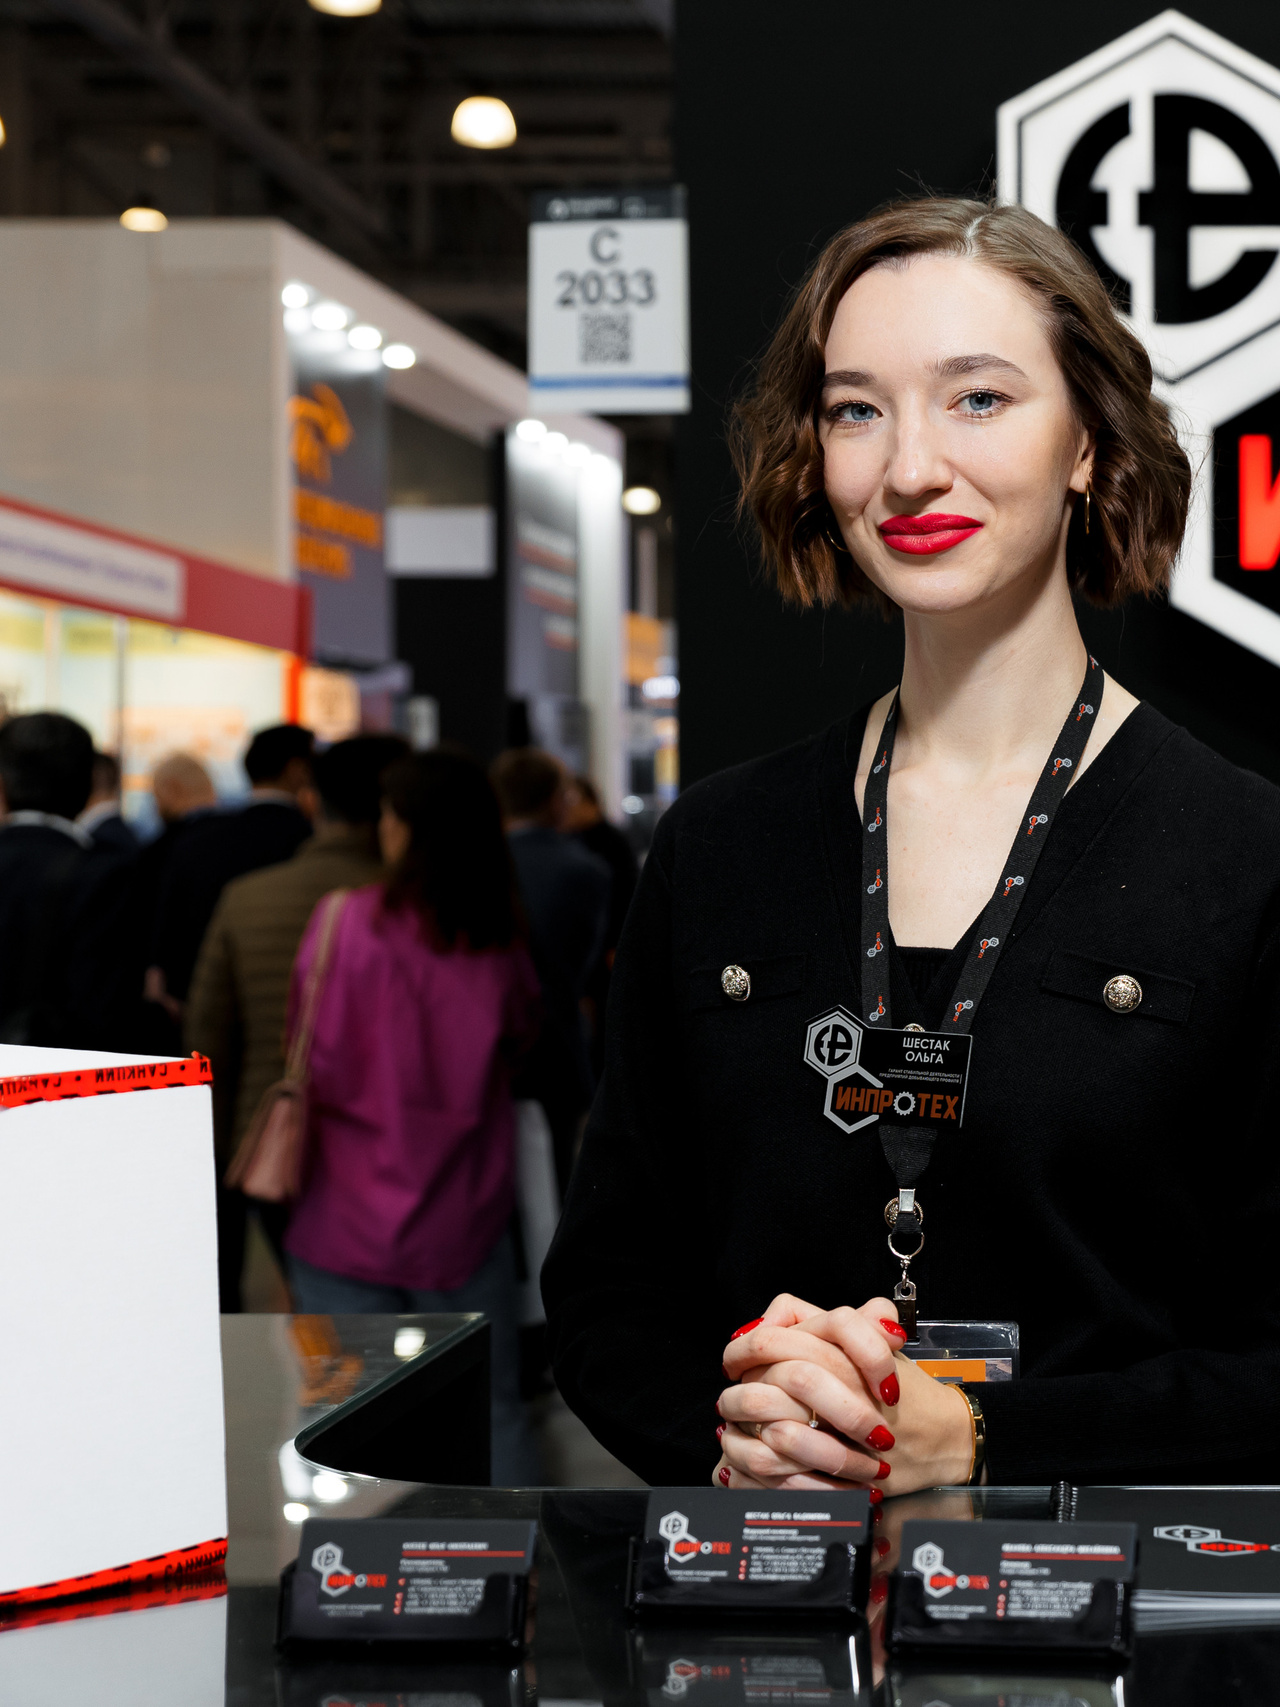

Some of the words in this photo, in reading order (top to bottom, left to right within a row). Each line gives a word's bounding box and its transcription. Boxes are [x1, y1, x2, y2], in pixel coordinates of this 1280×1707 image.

[556, 270, 655, 307] 2033
[903, 1037, 951, 1051] ШЕСТАК
[905, 1051, 944, 1064] ОЛЬГА
[835, 1086, 959, 1120] ИНПРОТЕХ
